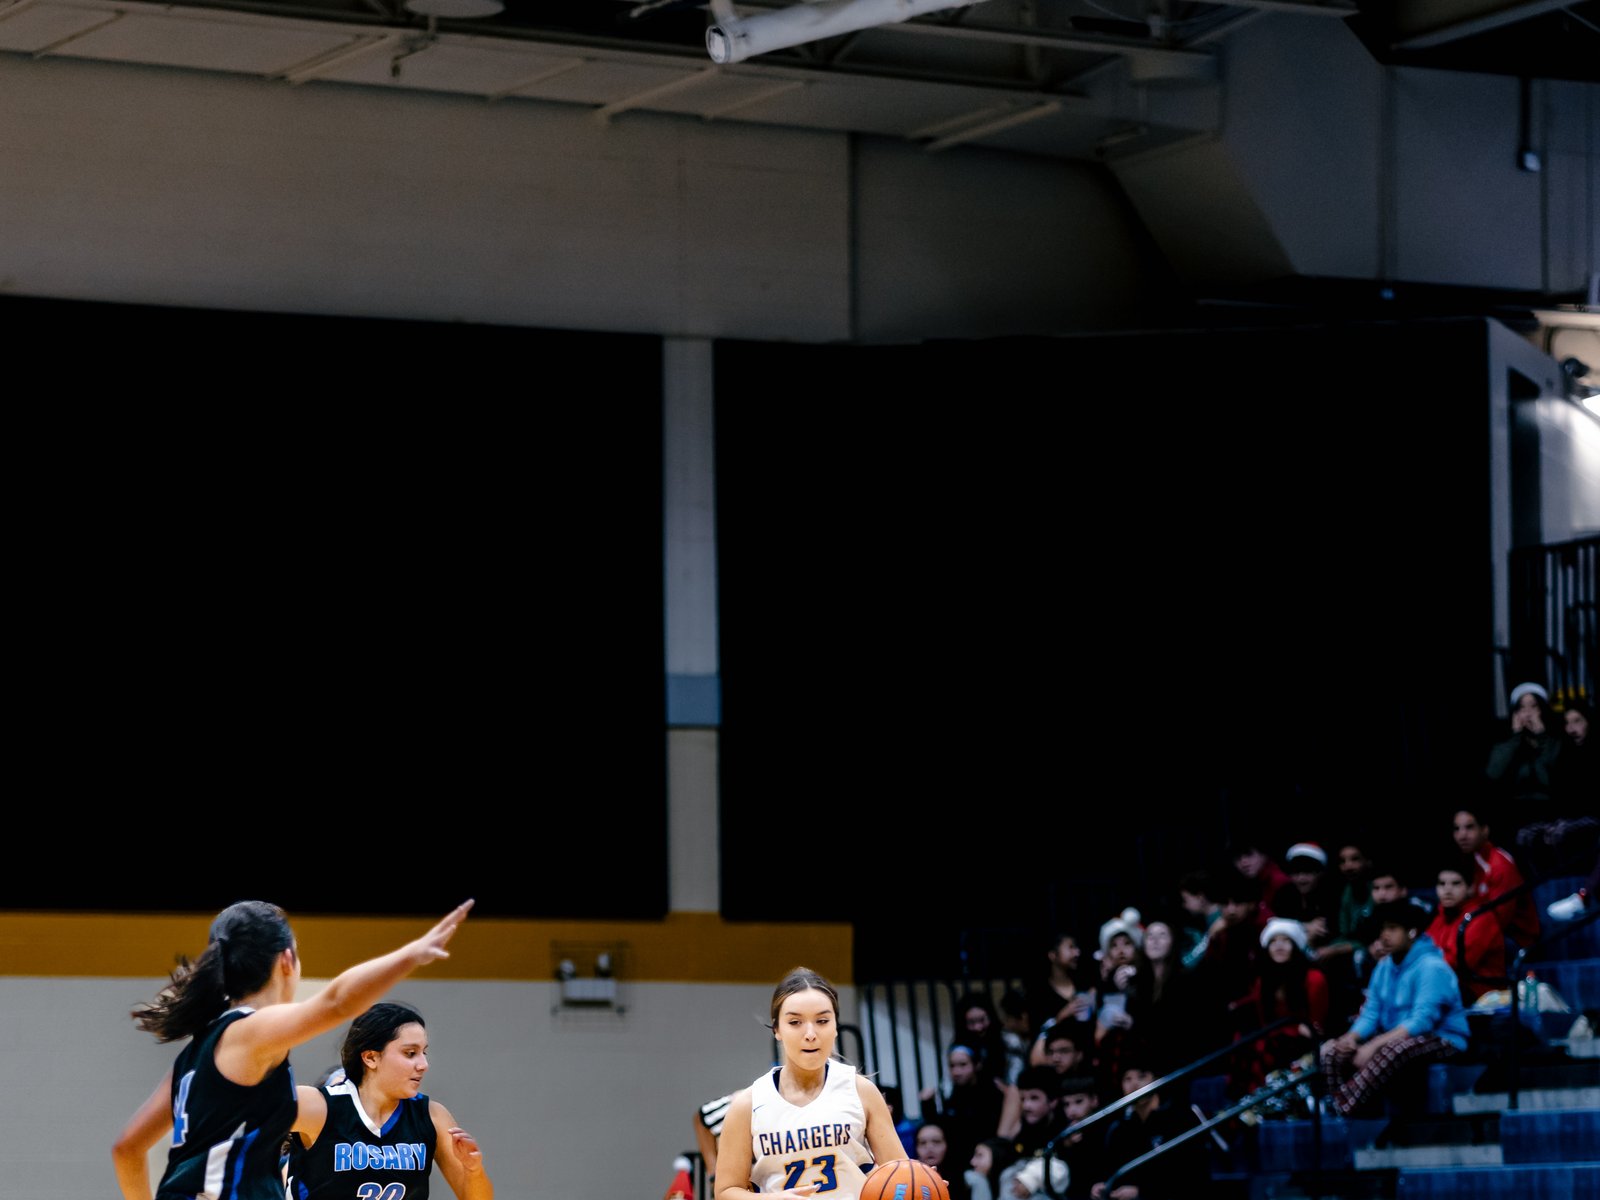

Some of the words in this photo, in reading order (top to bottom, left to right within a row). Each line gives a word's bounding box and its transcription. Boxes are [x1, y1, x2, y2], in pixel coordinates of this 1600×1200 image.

[759, 1123, 851, 1156] CHARGERS
[334, 1141, 427, 1172] ROSARY
[783, 1153, 839, 1194] 23
